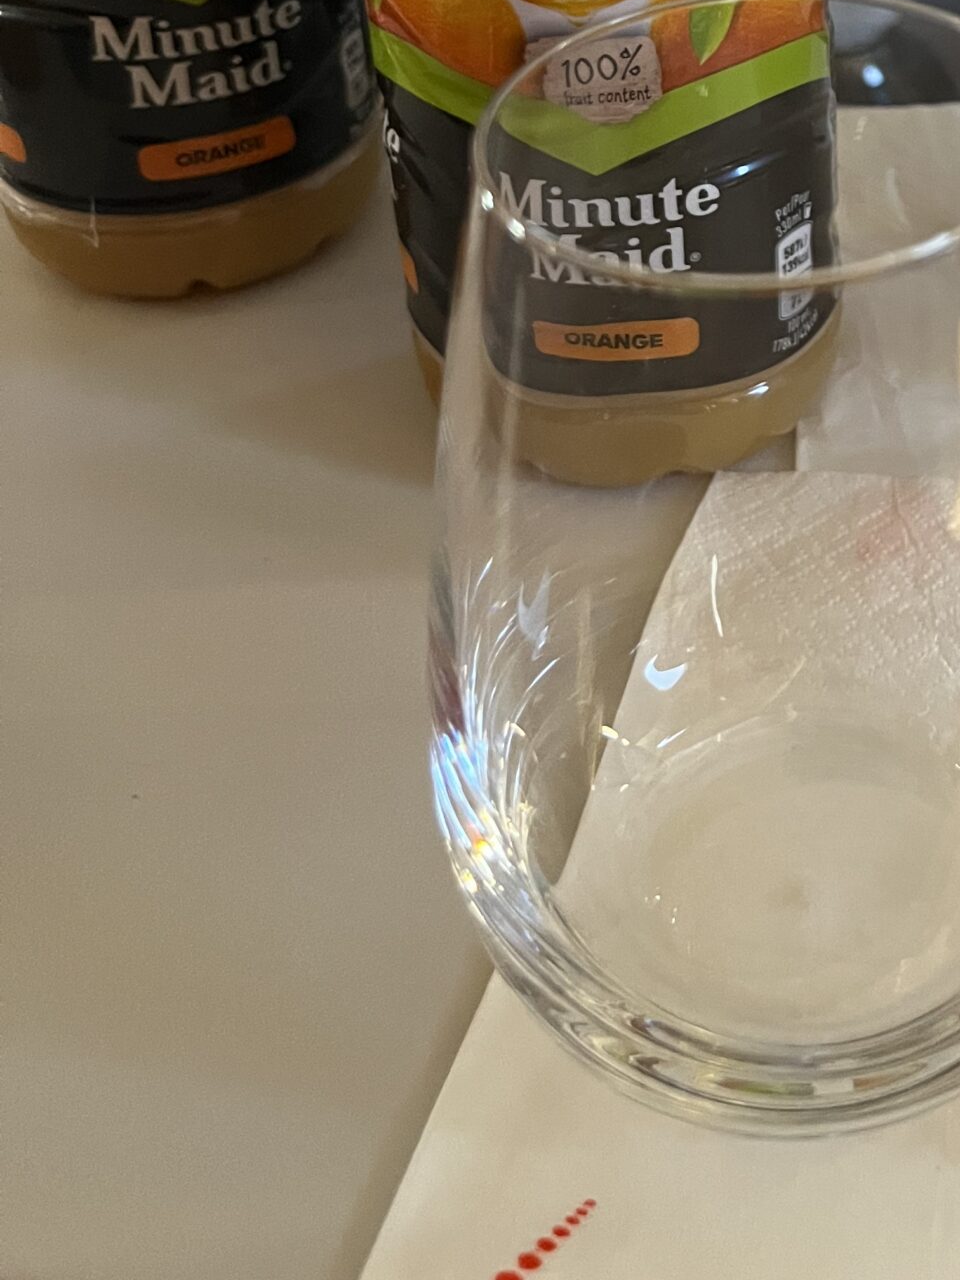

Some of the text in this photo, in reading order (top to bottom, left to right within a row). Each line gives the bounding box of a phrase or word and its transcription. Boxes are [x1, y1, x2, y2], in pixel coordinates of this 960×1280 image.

[89, 0, 302, 62] Minute
[125, 40, 287, 109] Maid
[561, 43, 643, 88] 100%
[597, 86, 652, 106] content
[175, 134, 267, 168] ORANGE
[500, 171, 721, 228] Minute
[564, 332, 664, 350] ORANGE
